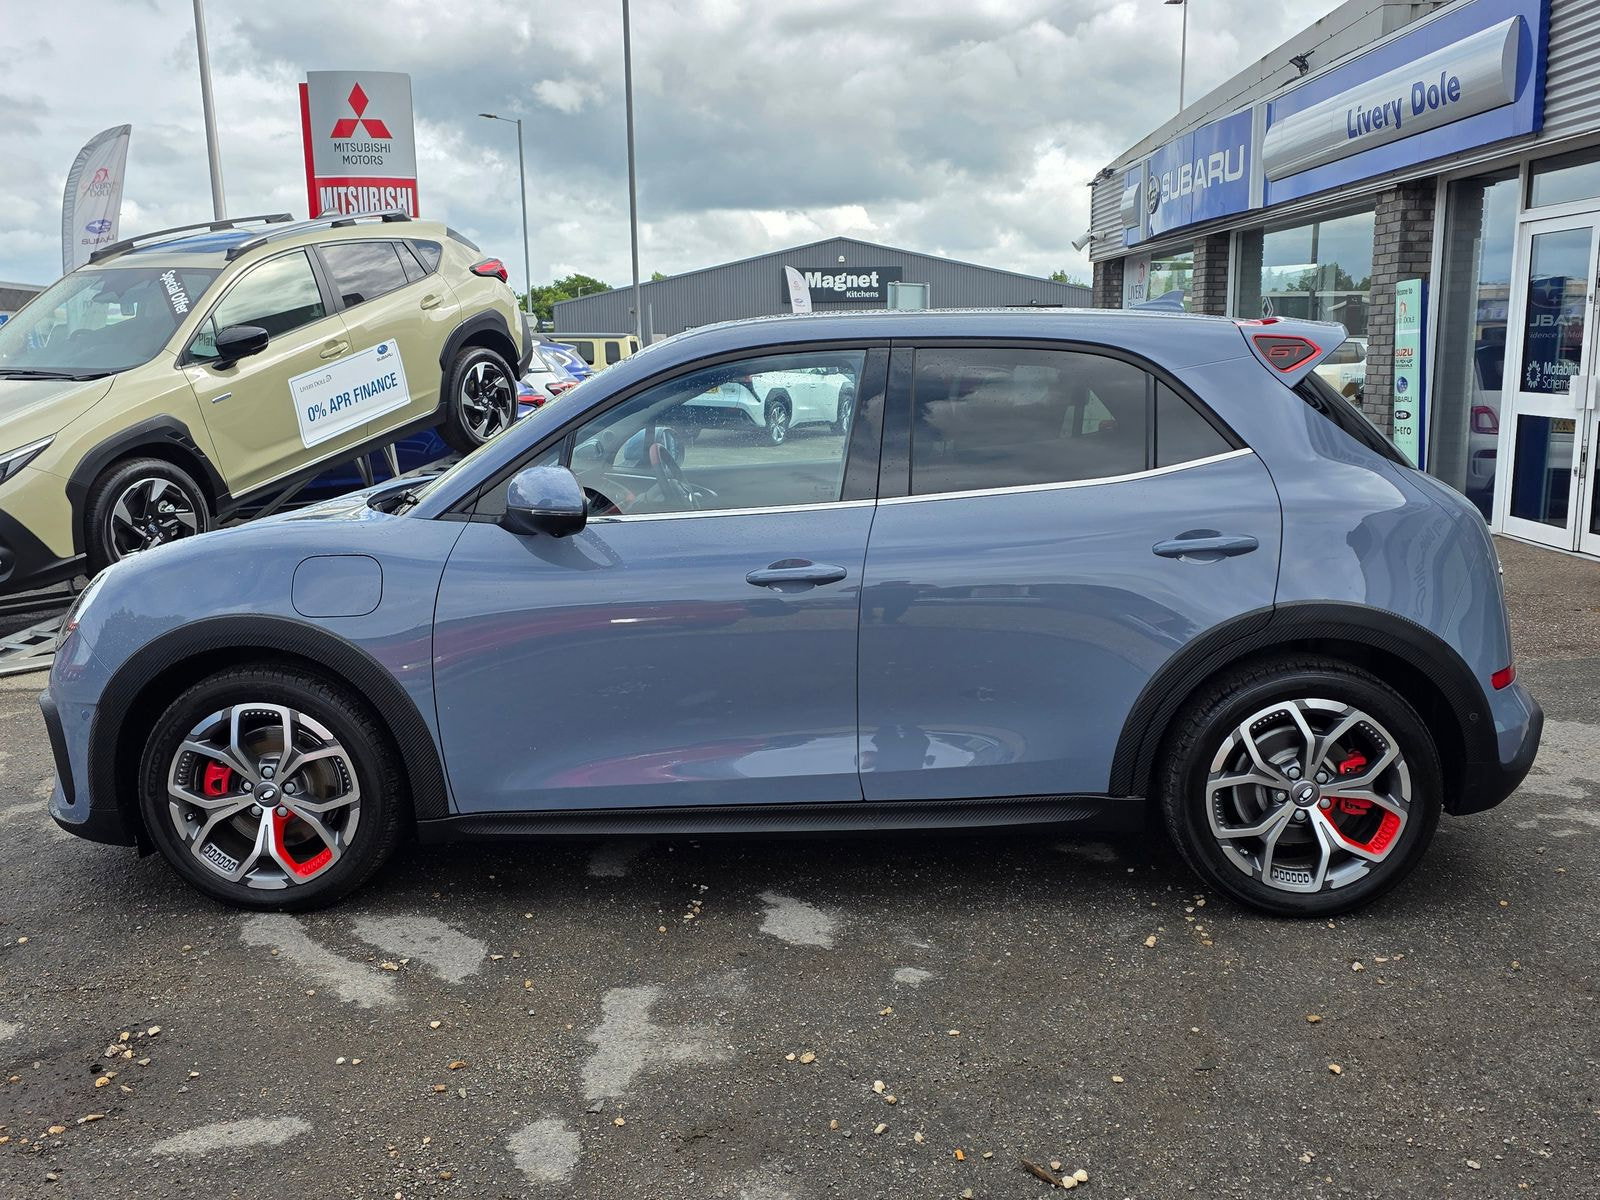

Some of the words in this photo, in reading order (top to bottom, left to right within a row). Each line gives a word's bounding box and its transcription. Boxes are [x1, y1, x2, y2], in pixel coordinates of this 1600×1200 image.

[1347, 96, 1402, 139] Livery
[1411, 71, 1461, 116] Dole
[334, 142, 391, 153] MITSUBISHI
[342, 155, 384, 166] MOTORS
[1161, 144, 1245, 205] SUBARU
[320, 186, 414, 217] MITSUBISHI
[159, 269, 184, 295] Special
[804, 271, 879, 291] Magnet
[846, 290, 879, 298] Kitchens
[171, 291, 190, 315] Offer
[376, 352, 393, 362] SUBARU
[1269, 344, 1305, 358] GT
[1543, 361, 1580, 376] Motability
[1542, 376, 1570, 389] Scheme
[307, 402, 327, 422] 0%
[329, 391, 352, 414] APR
[352, 371, 398, 403] FINANCE
